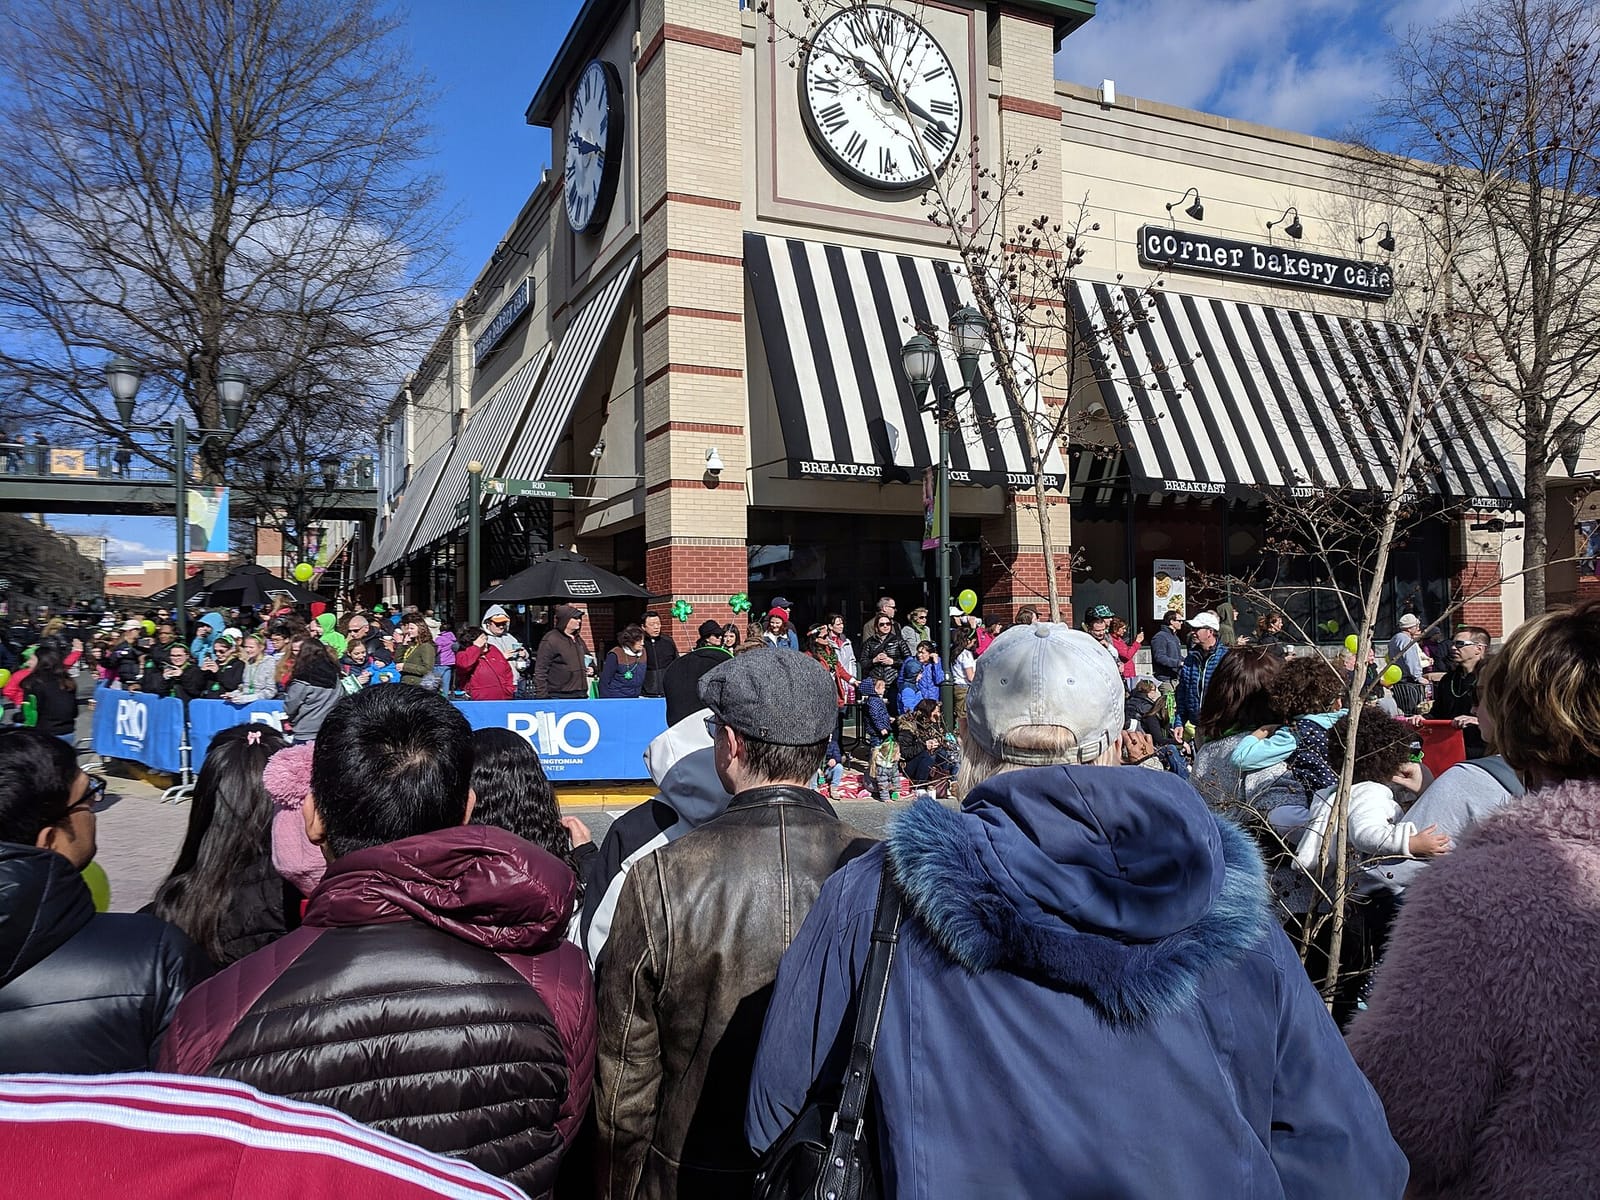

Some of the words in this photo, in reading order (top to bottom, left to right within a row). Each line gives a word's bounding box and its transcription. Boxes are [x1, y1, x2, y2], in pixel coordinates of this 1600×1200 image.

[922, 67, 946, 83] II
[930, 100, 954, 116] III
[1148, 235, 1243, 267] corner
[1251, 246, 1339, 284] bakery
[800, 461, 883, 477] BREAKFAST
[520, 489, 557, 497] BOULEVARD
[532, 481, 546, 490] RIO
[1164, 480, 1226, 494] BREAKFAST
[1471, 497, 1513, 509] CATERING
